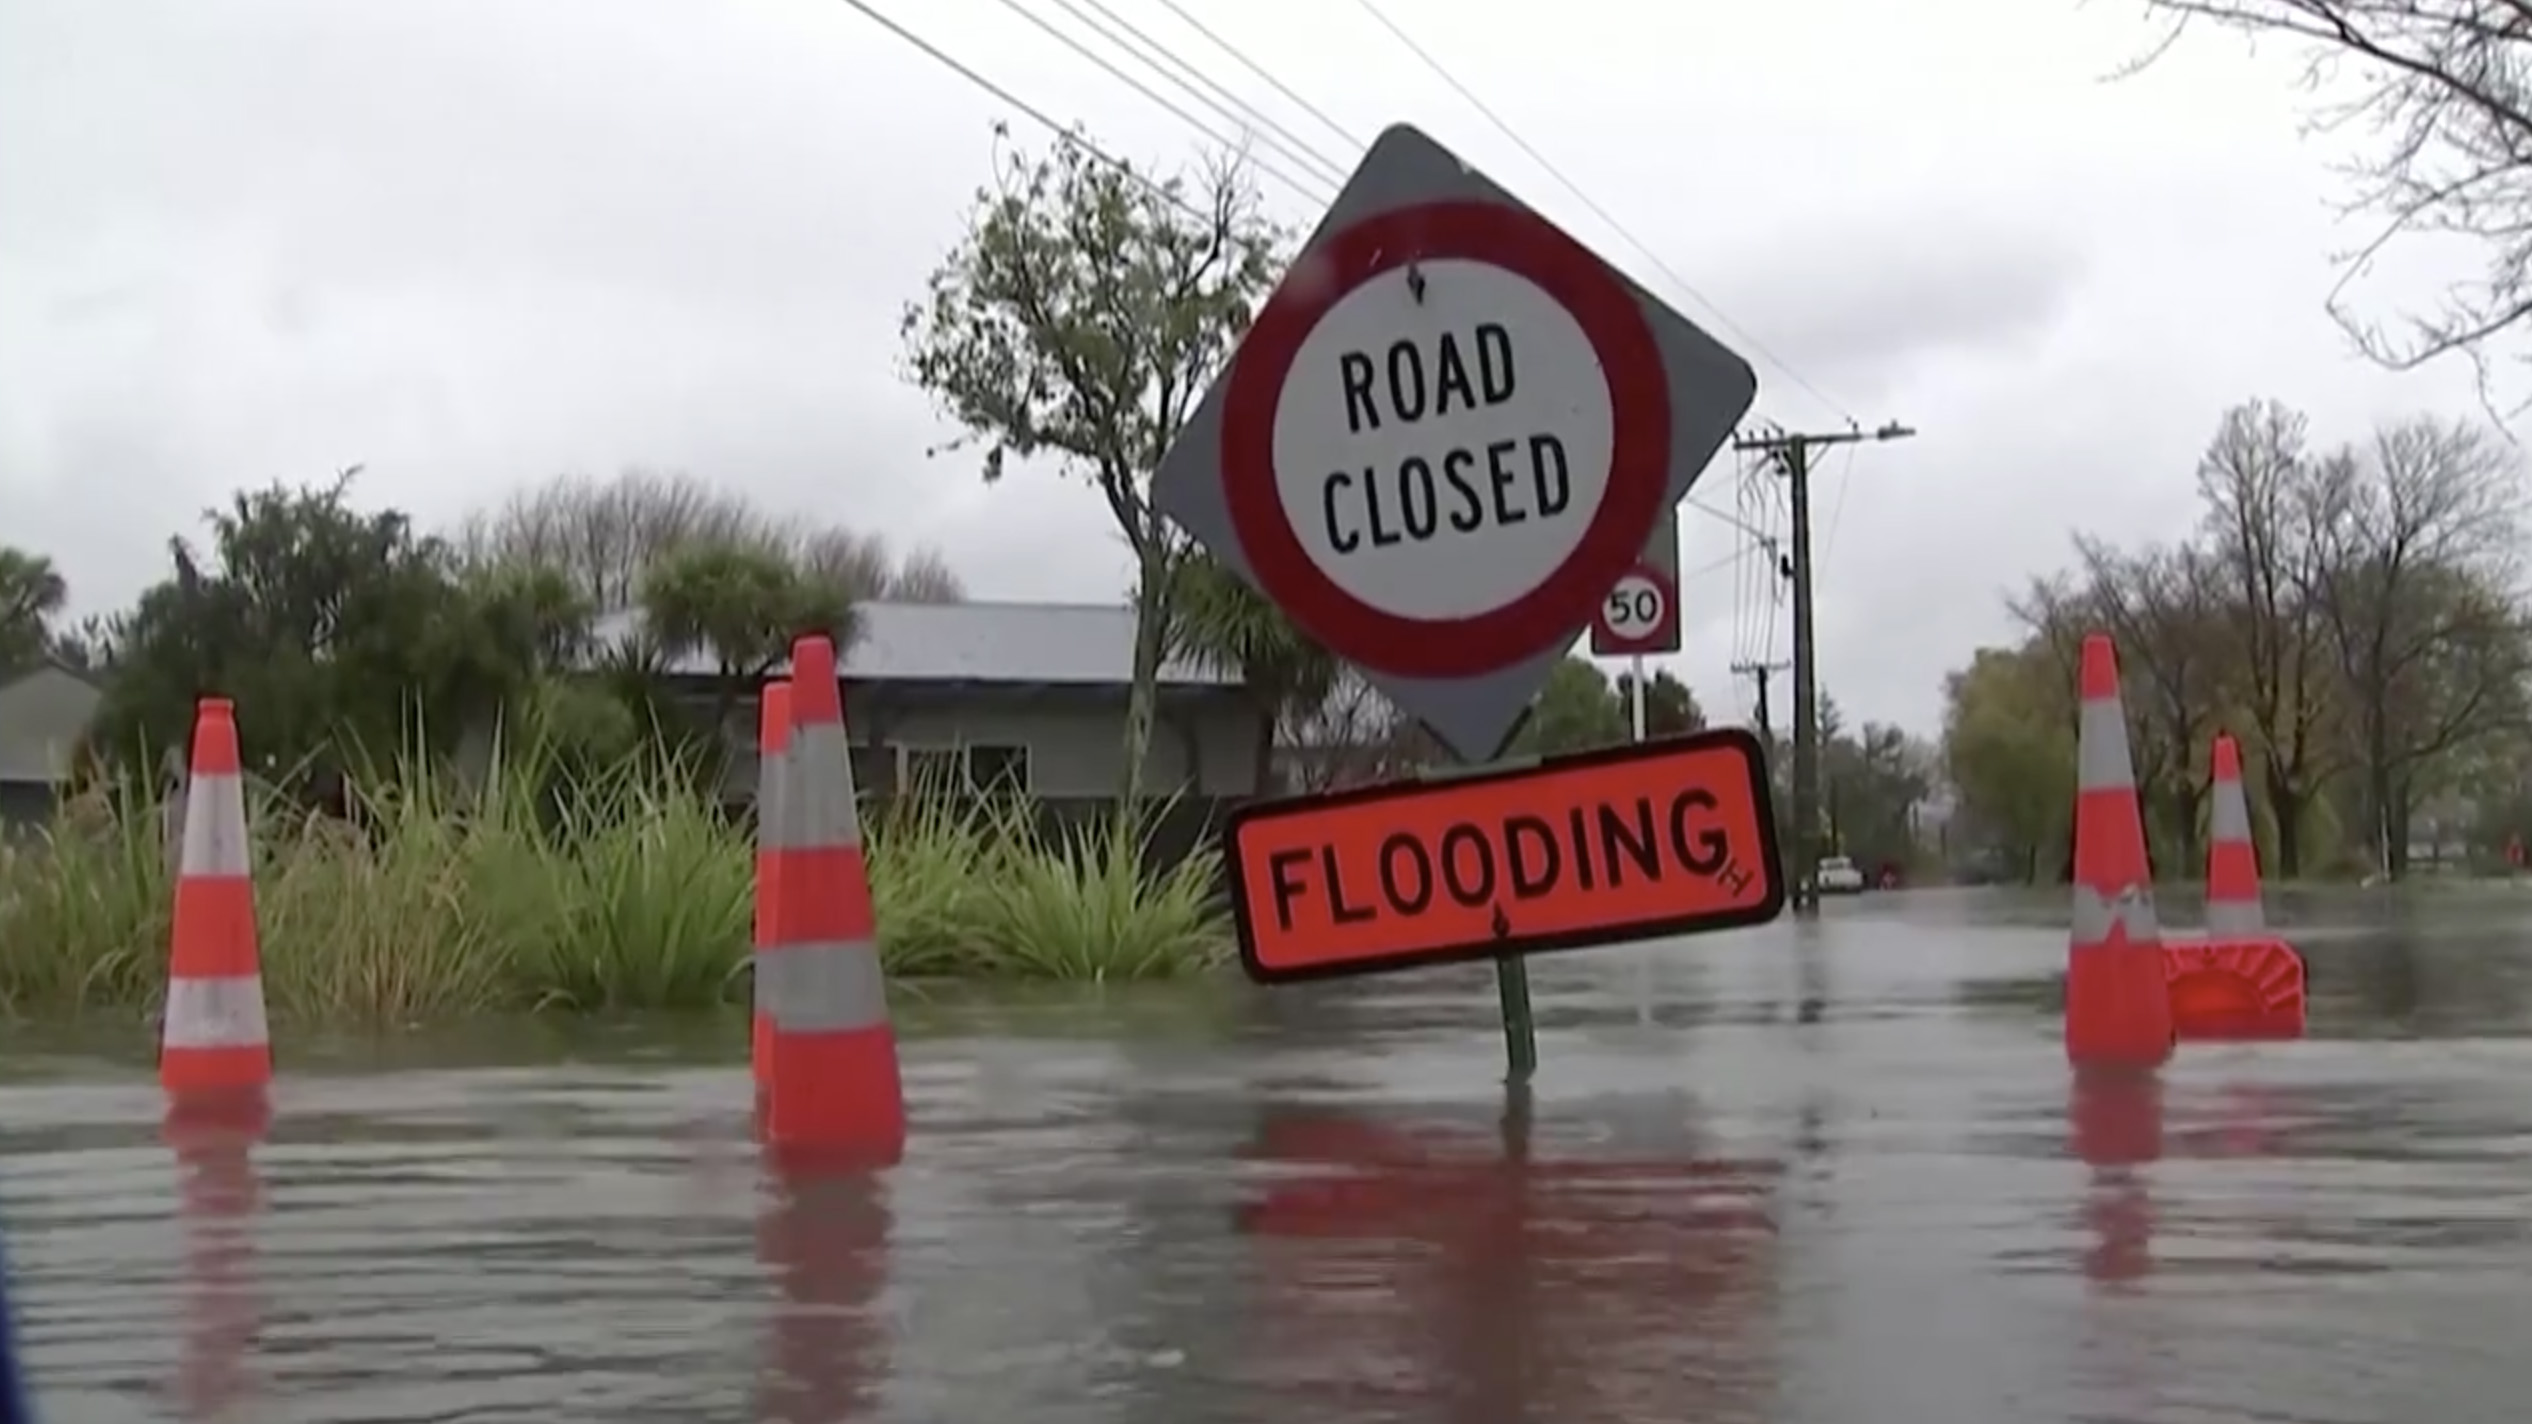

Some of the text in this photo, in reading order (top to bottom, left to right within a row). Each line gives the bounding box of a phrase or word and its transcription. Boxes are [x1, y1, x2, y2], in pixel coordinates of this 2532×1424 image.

[1340, 322, 1516, 433] ROAD
[1323, 433, 1570, 554] CLOSED
[1610, 589, 1658, 624] 50
[1269, 788, 1728, 932] FLOODING
